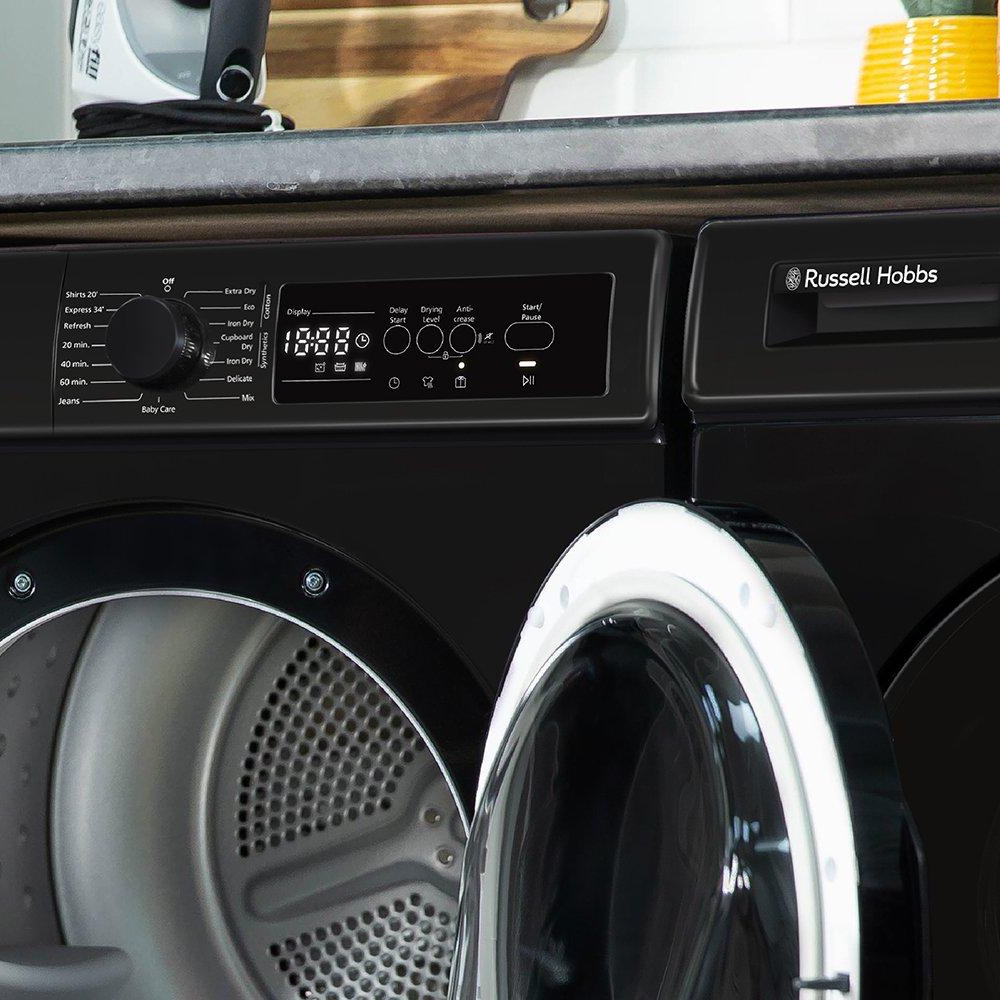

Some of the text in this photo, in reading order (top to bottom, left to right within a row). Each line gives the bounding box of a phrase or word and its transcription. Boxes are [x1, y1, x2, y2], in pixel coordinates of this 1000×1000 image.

[804, 263, 938, 289] Russell Hobbs
[162, 277, 175, 285] Off
[65, 306, 92, 314] Express
[287, 307, 312, 316] Display
[389, 306, 408, 315] Delay
[420, 306, 443, 314] Drying
[456, 304, 474, 313] Anti-
[522, 303, 543, 312] Start/
[389, 315, 406, 323] Start
[422, 315, 440, 323] Level
[453, 314, 475, 323] crease
[521, 313, 542, 321] Pause
[63, 322, 91, 330] Refresh
[241, 320, 254, 328] Dry
[241, 343, 253, 351] Dry
[260, 332, 269, 369] Synthetics
[240, 358, 253, 366] Dry
[227, 375, 253, 383] Delicate
[58, 397, 80, 406] Jeans
[142, 406, 159, 414] Baby
